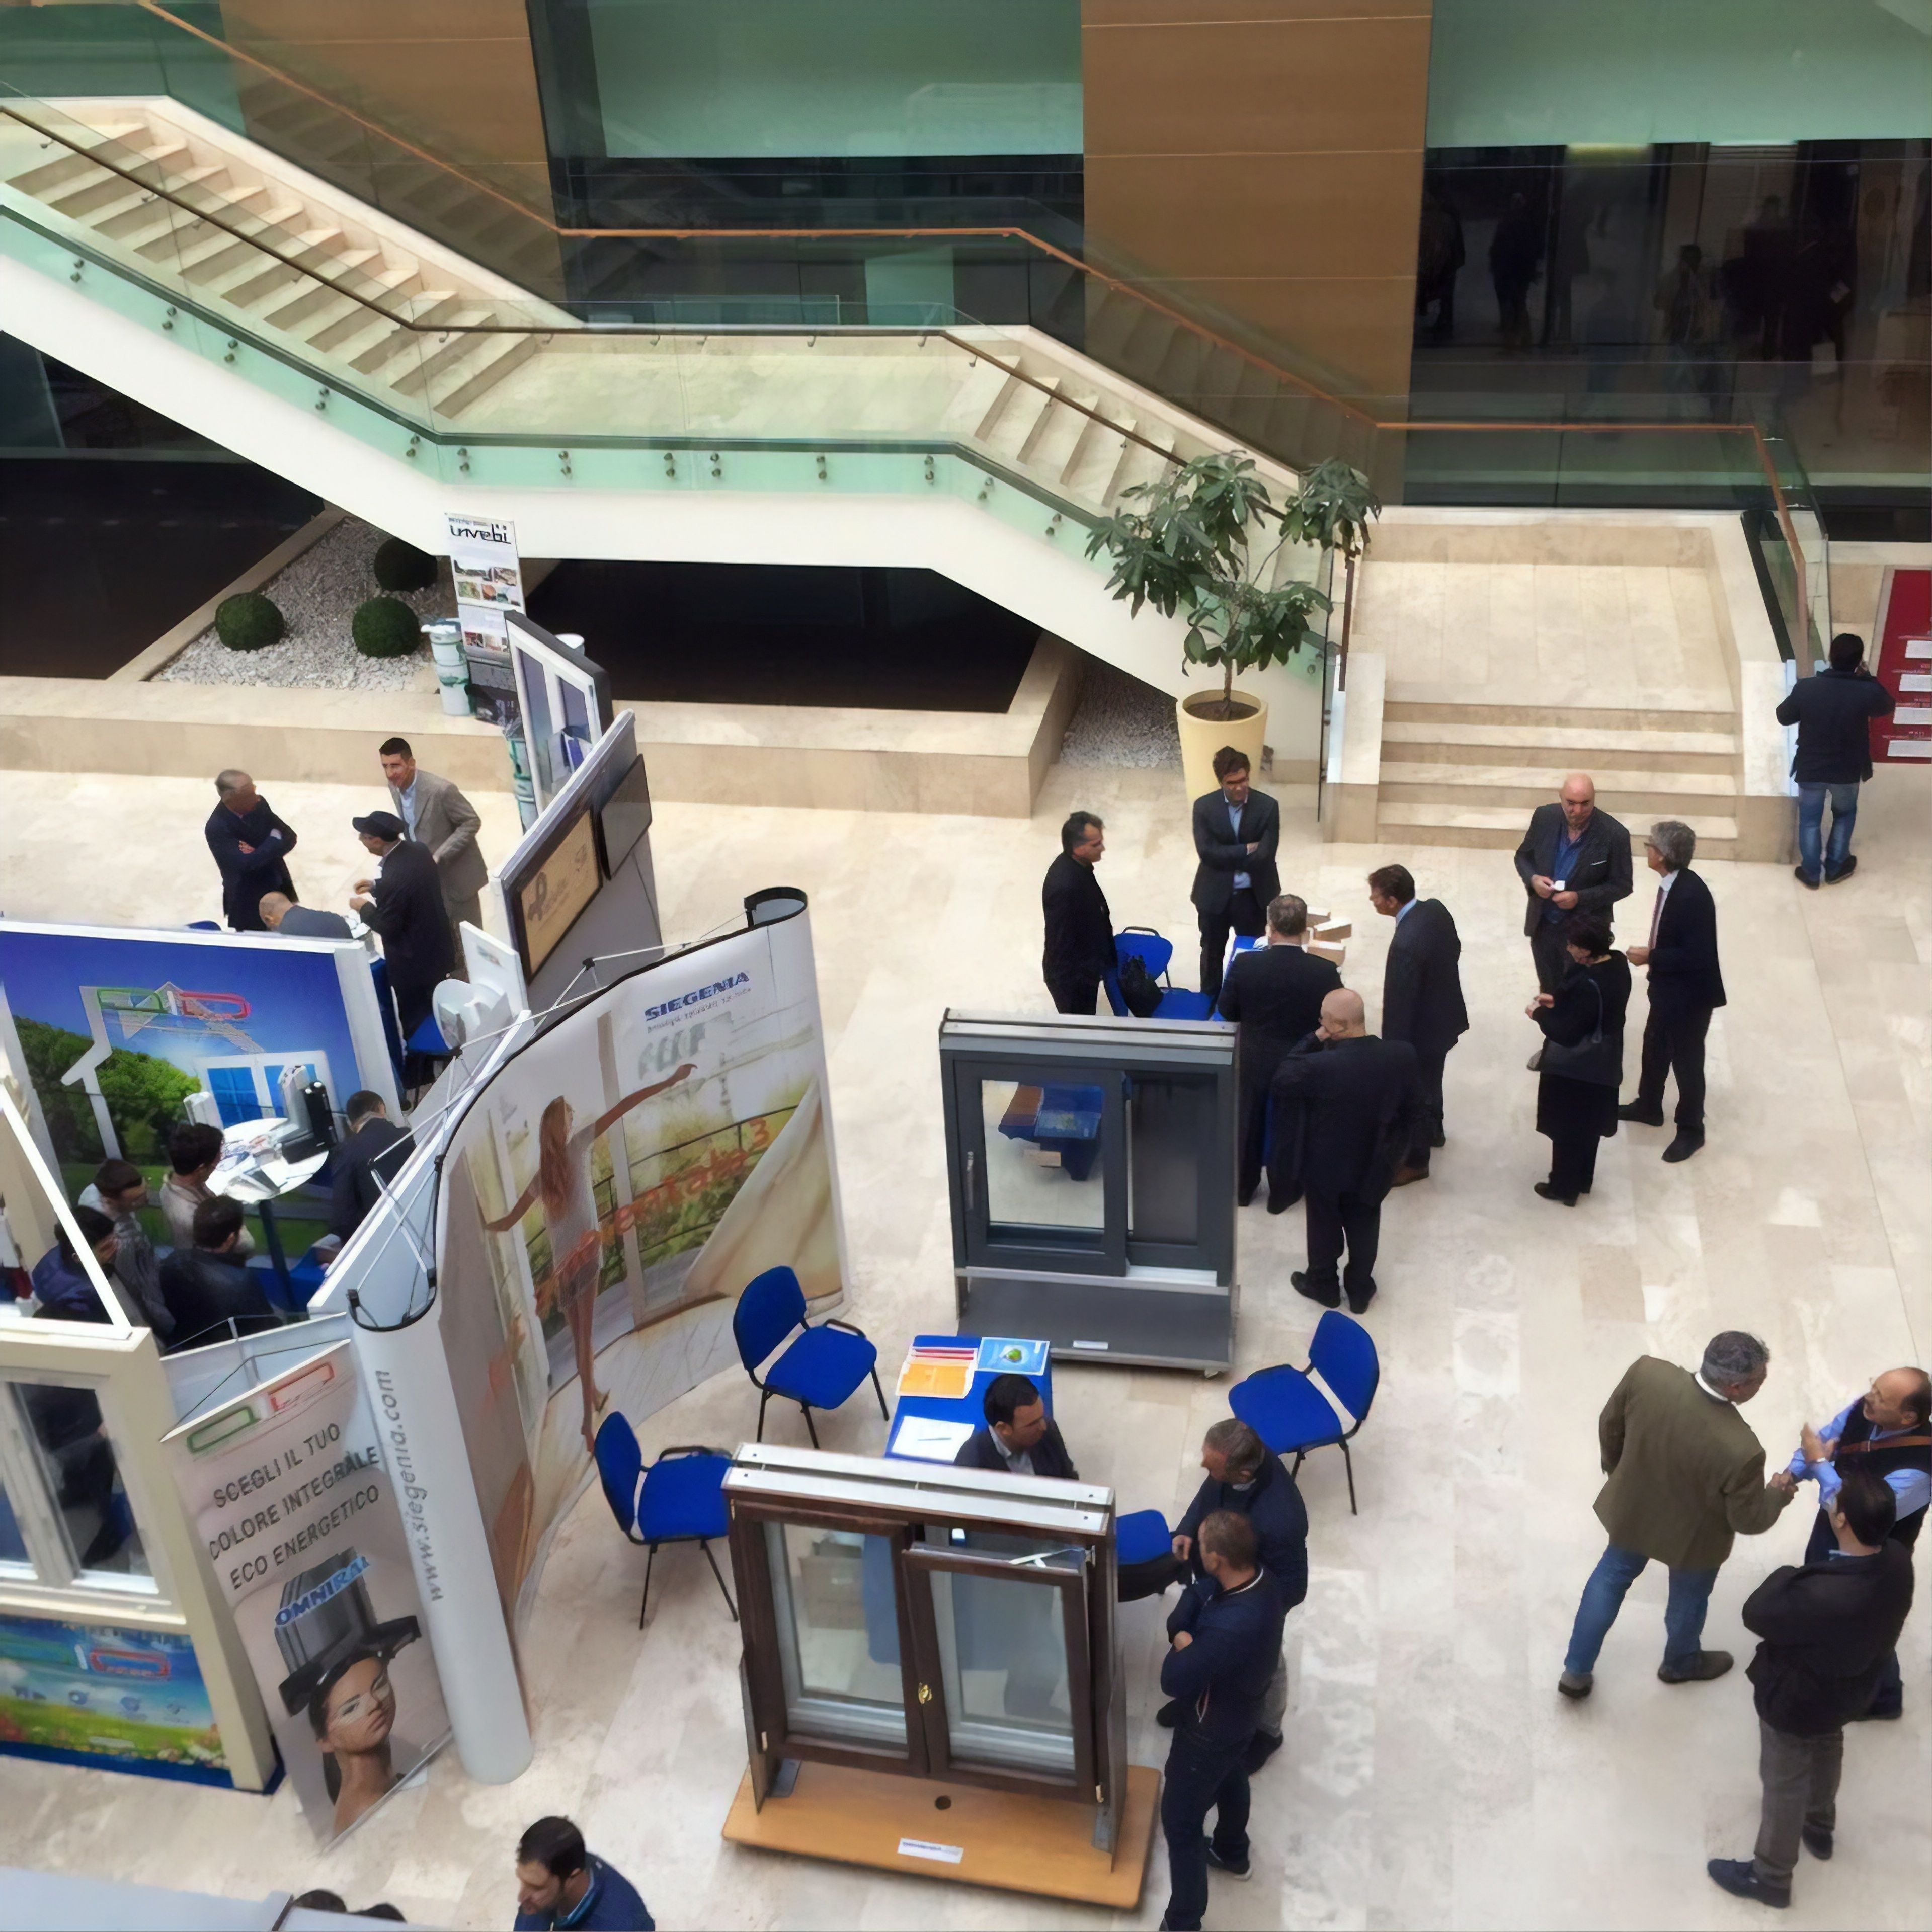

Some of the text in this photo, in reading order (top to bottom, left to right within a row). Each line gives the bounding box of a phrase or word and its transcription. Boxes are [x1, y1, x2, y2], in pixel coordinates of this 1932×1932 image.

[645, 972, 750, 1021] SIEGENIA
[209, 1446, 380, 1561] COLORE INTEGRALE
[213, 1423, 341, 1508] SCEGLI IL TUO
[375, 1370, 444, 1602] www.siegenia.com
[230, 1485, 379, 1590] ECO ENERGETICO
